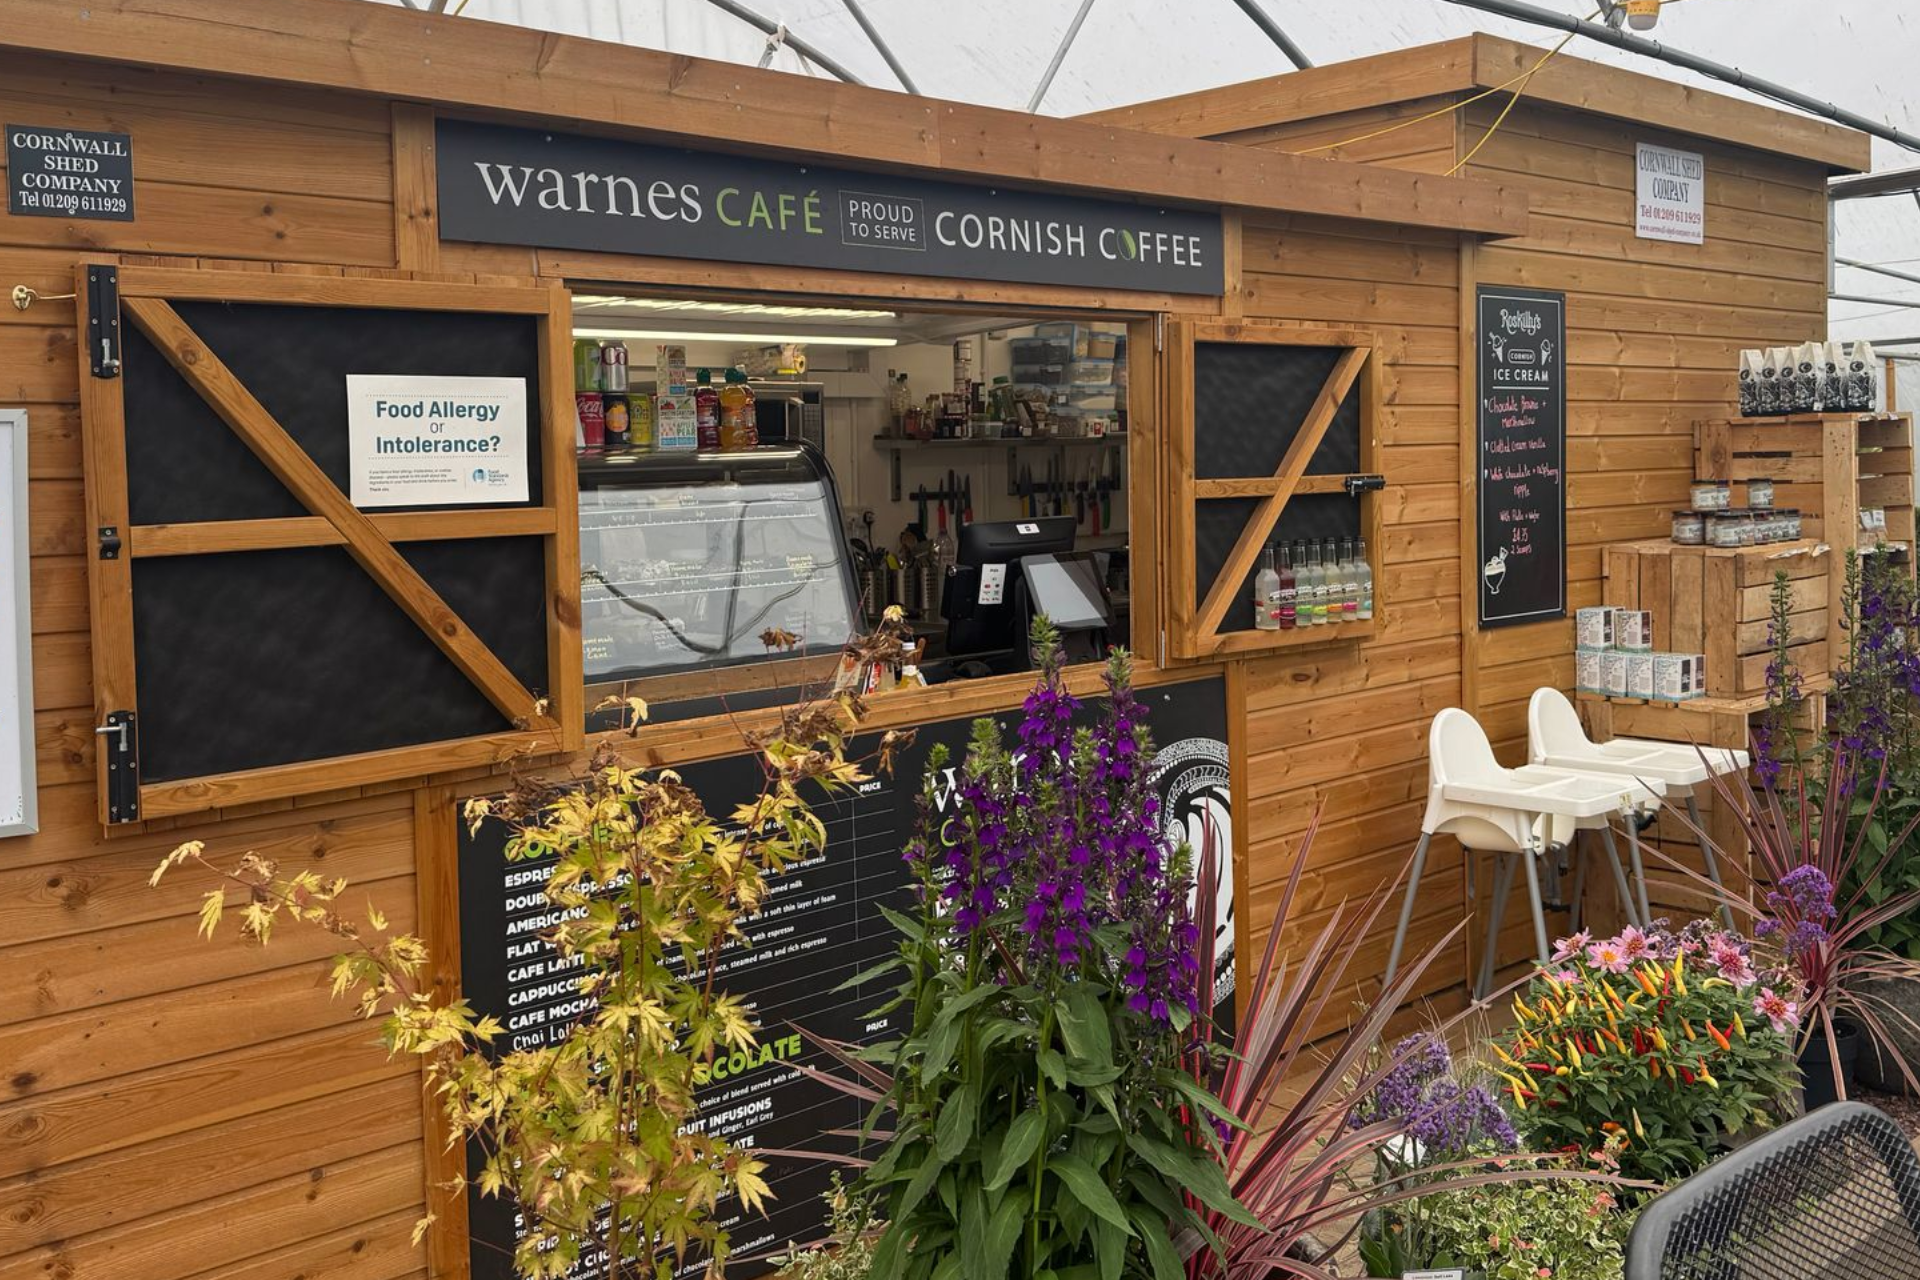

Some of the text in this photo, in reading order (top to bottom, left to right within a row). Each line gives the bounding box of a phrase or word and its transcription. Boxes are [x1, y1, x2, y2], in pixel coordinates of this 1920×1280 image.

[13, 133, 127, 156] CORNWALL
[44, 155, 98, 173] SHED
[1640, 149, 1700, 180] CORNWALL SHED
[22, 173, 122, 194] COMPANY
[1653, 177, 1689, 203] COMPANY
[19, 191, 127, 213] Tel 01209 611929
[474, 162, 823, 234] warnes CAFÉ
[849, 200, 914, 223] PROUD
[1641, 205, 1700, 225] Tel 01209 611929
[850, 222, 916, 242] TO SERVE
[935, 211, 1202, 267] CORNISH COFFEE
[1493, 368, 1549, 382] ICE CREAM
[376, 401, 500, 421] Food Allergy
[430, 422, 445, 434] or
[376, 435, 501, 454] Intolerance?
[859, 781, 881, 793] PRICE
[790, 879, 803, 890] milk
[506, 892, 548, 912] DOUB
[770, 907, 782, 917] soft
[783, 903, 796, 913] thin
[797, 901, 812, 911] layer
[821, 894, 836, 903] foam
[752, 933, 766, 942] with
[767, 926, 795, 939] espresso
[506, 940, 541, 959] FLAT
[730, 955, 758, 969] steamed
[759, 950, 774, 961] milk
[774, 947, 787, 957] and
[788, 942, 800, 953] rich
[801, 937, 827, 950] espresso
[508, 963, 544, 982] CAFE
[509, 997, 599, 1030] CAFE MOCHA
[866, 1019, 888, 1033] PRICE
[513, 1030, 545, 1052] Chai
[700, 1069, 801, 1108] choice of blend served with cold
[710, 1097, 772, 1127] INFUSIONS
[722, 1122, 745, 1135] Ginger,
[746, 1116, 758, 1126] Earl
[759, 1111, 774, 1123] Grey
[720, 1215, 740, 1228] cream
[730, 1233, 775, 1255] marshmallows
